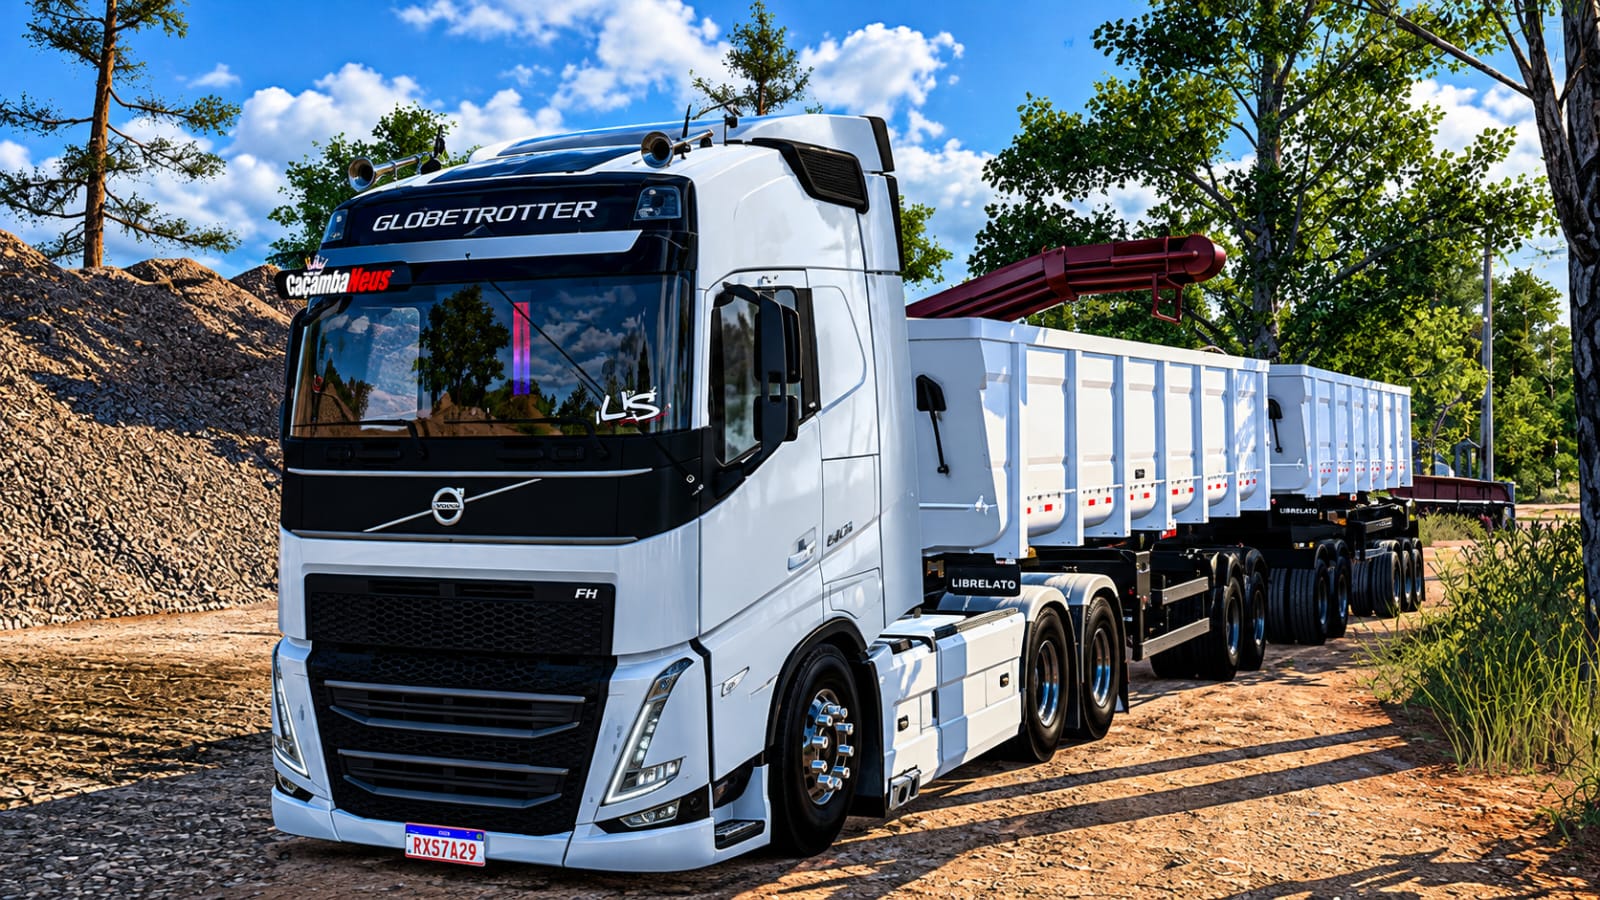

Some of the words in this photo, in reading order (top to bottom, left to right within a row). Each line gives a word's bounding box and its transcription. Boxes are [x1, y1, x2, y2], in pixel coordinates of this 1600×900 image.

[372, 201, 598, 231] GLOBETROTTER
[951, 578, 1017, 590] LIBRELATO
[574, 588, 599, 599] FH
[413, 836, 477, 861] RXS7A29
